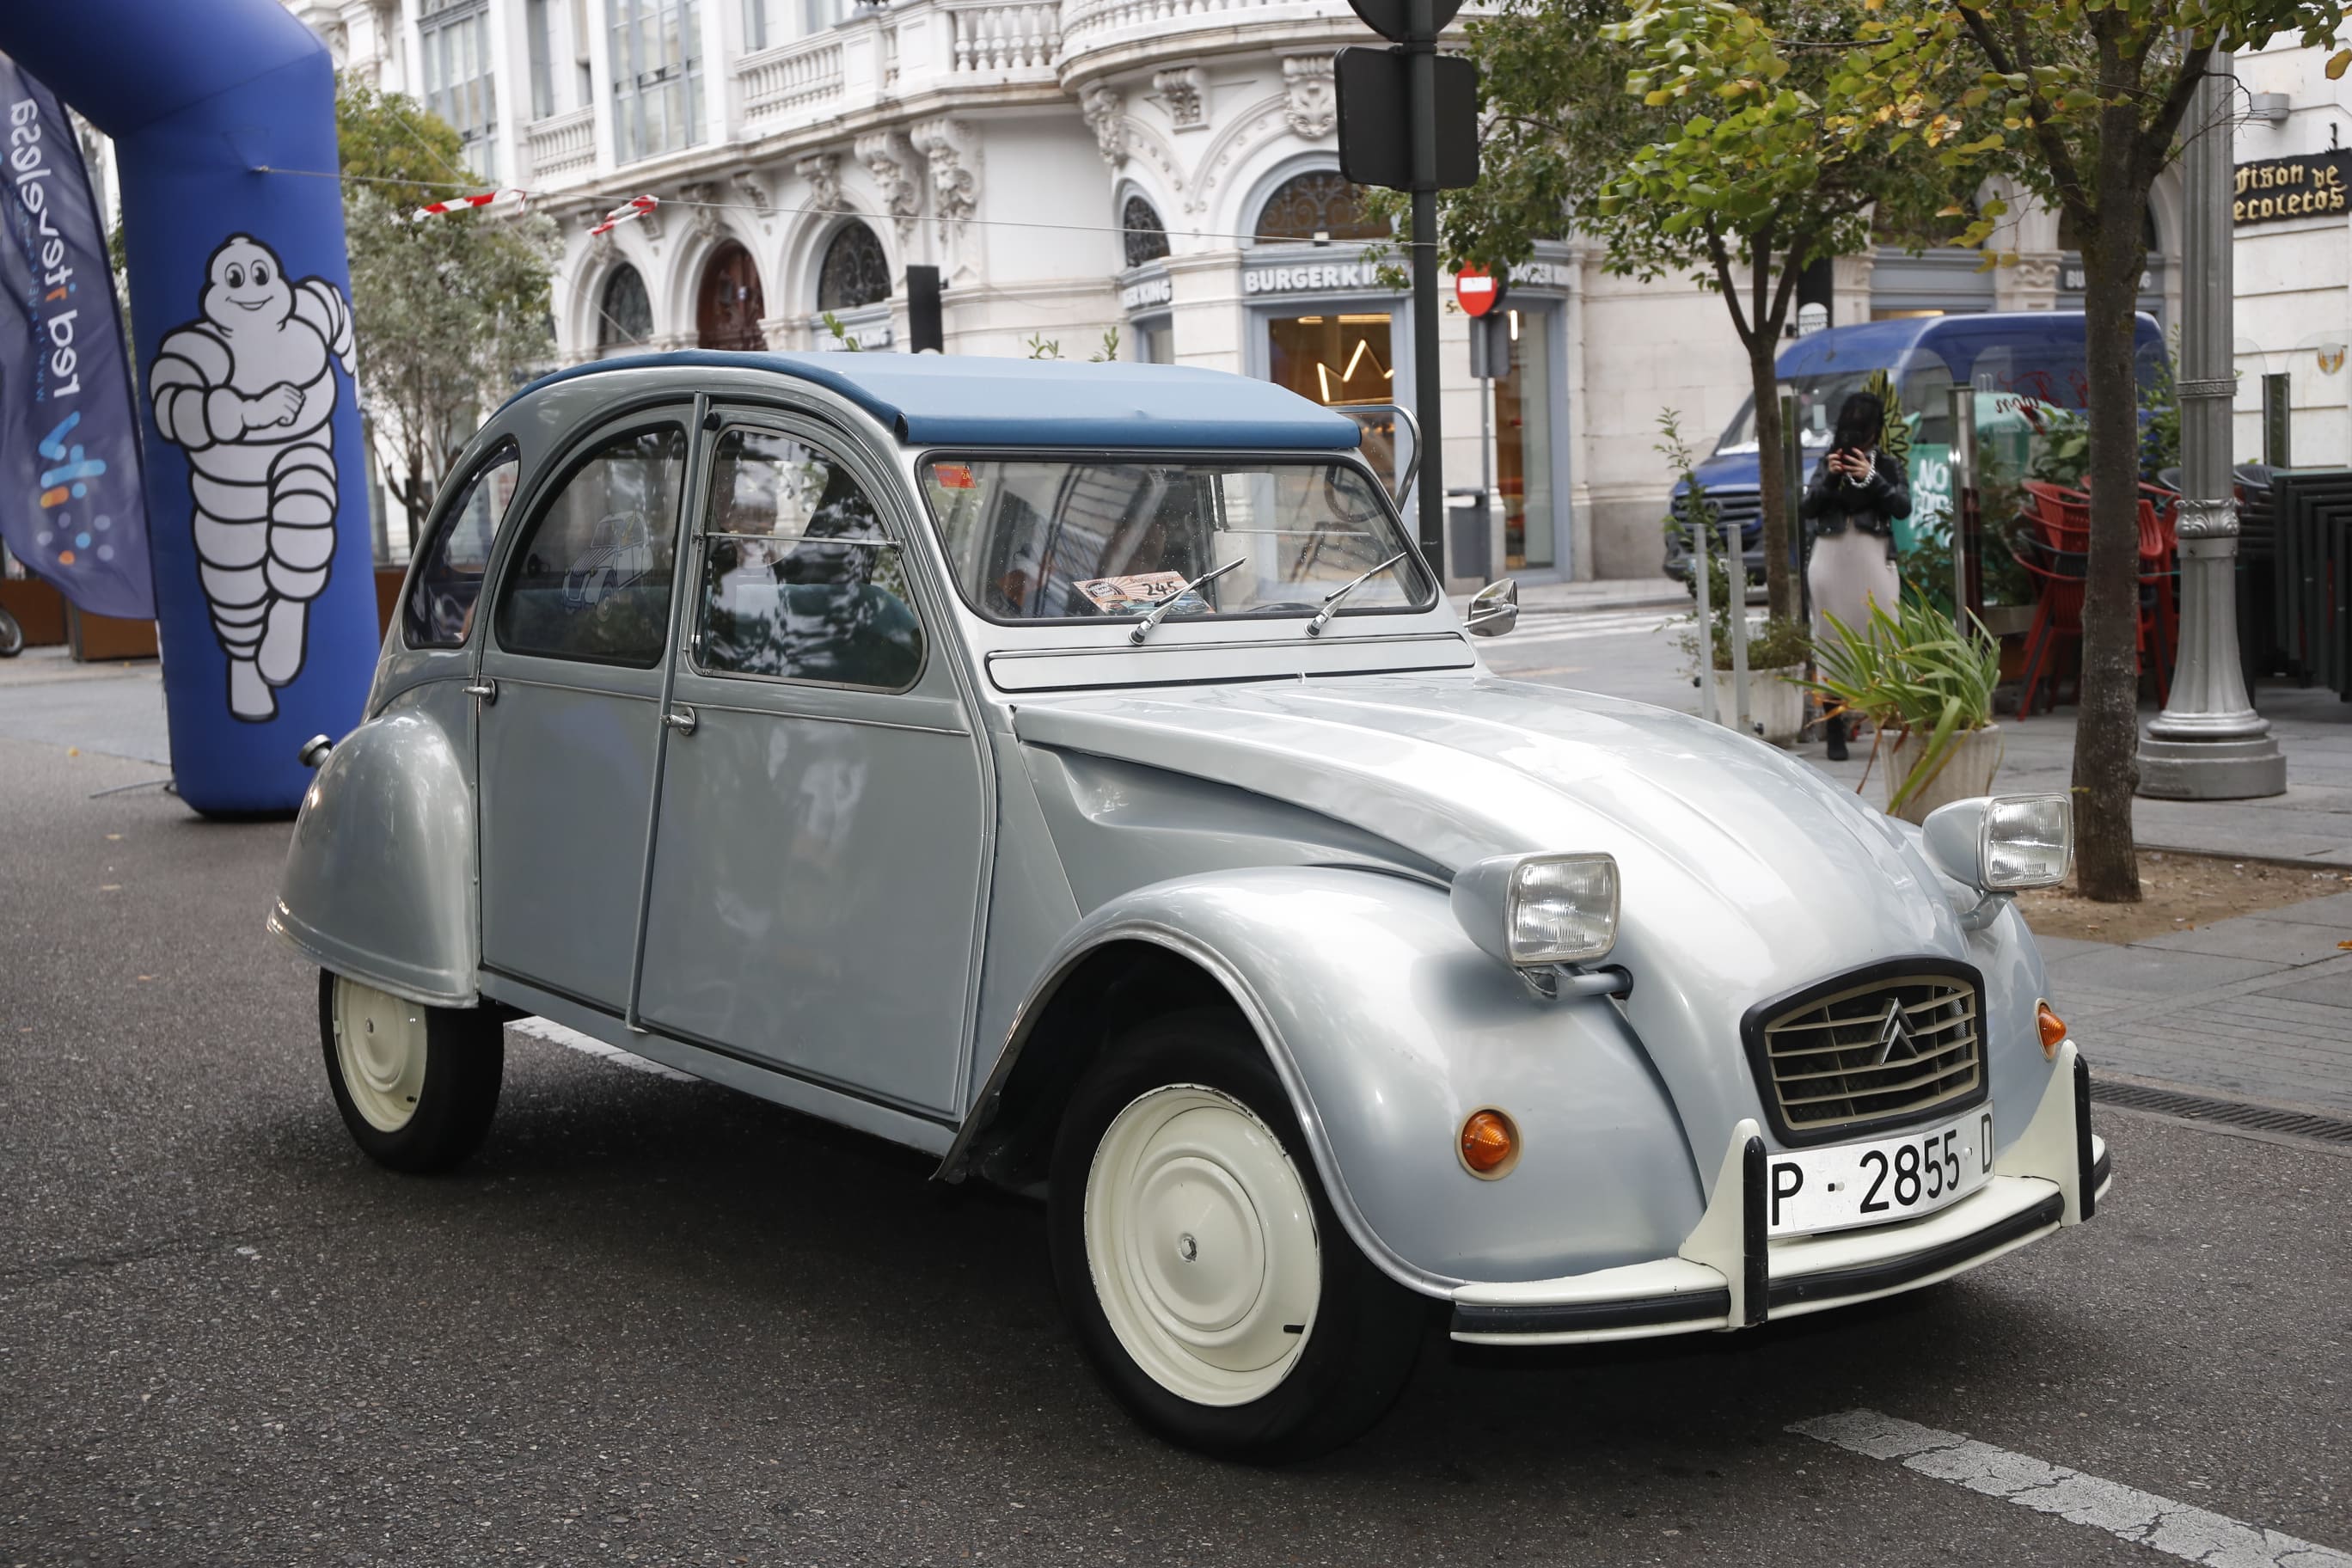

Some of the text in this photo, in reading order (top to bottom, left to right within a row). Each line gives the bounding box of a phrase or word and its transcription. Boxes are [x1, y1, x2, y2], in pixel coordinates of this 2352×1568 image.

[2233, 184, 2349, 222] ecoletos
[1245, 266, 1338, 292] BURGER
[1142, 581, 1178, 596] 245
